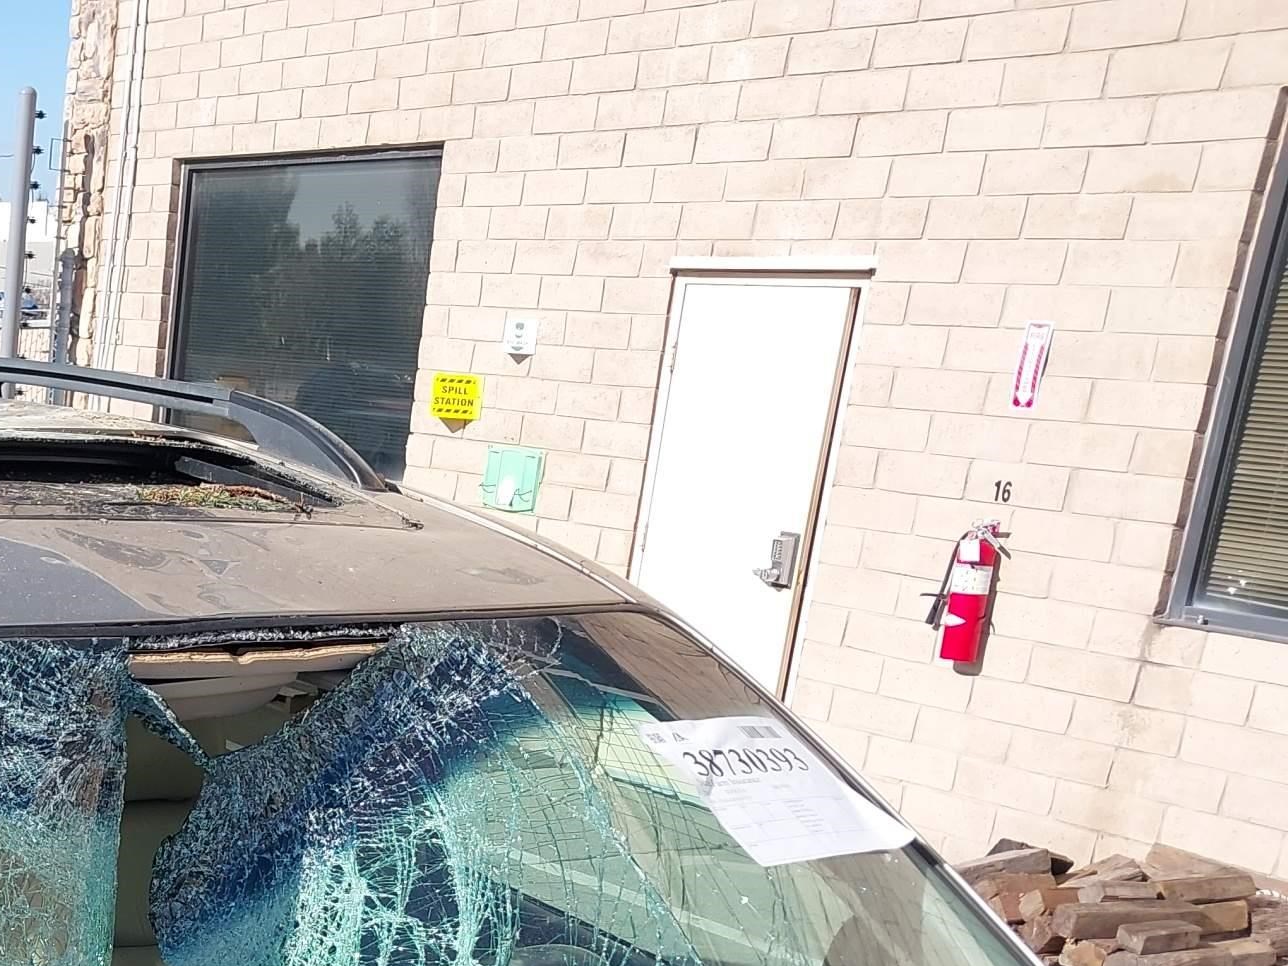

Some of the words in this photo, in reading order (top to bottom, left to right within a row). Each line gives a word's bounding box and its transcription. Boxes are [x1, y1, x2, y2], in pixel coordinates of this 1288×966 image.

[441, 385, 469, 395] SPILL
[434, 396, 474, 407] STATION
[993, 479, 1013, 503] 16
[682, 747, 809, 777] 38730393
